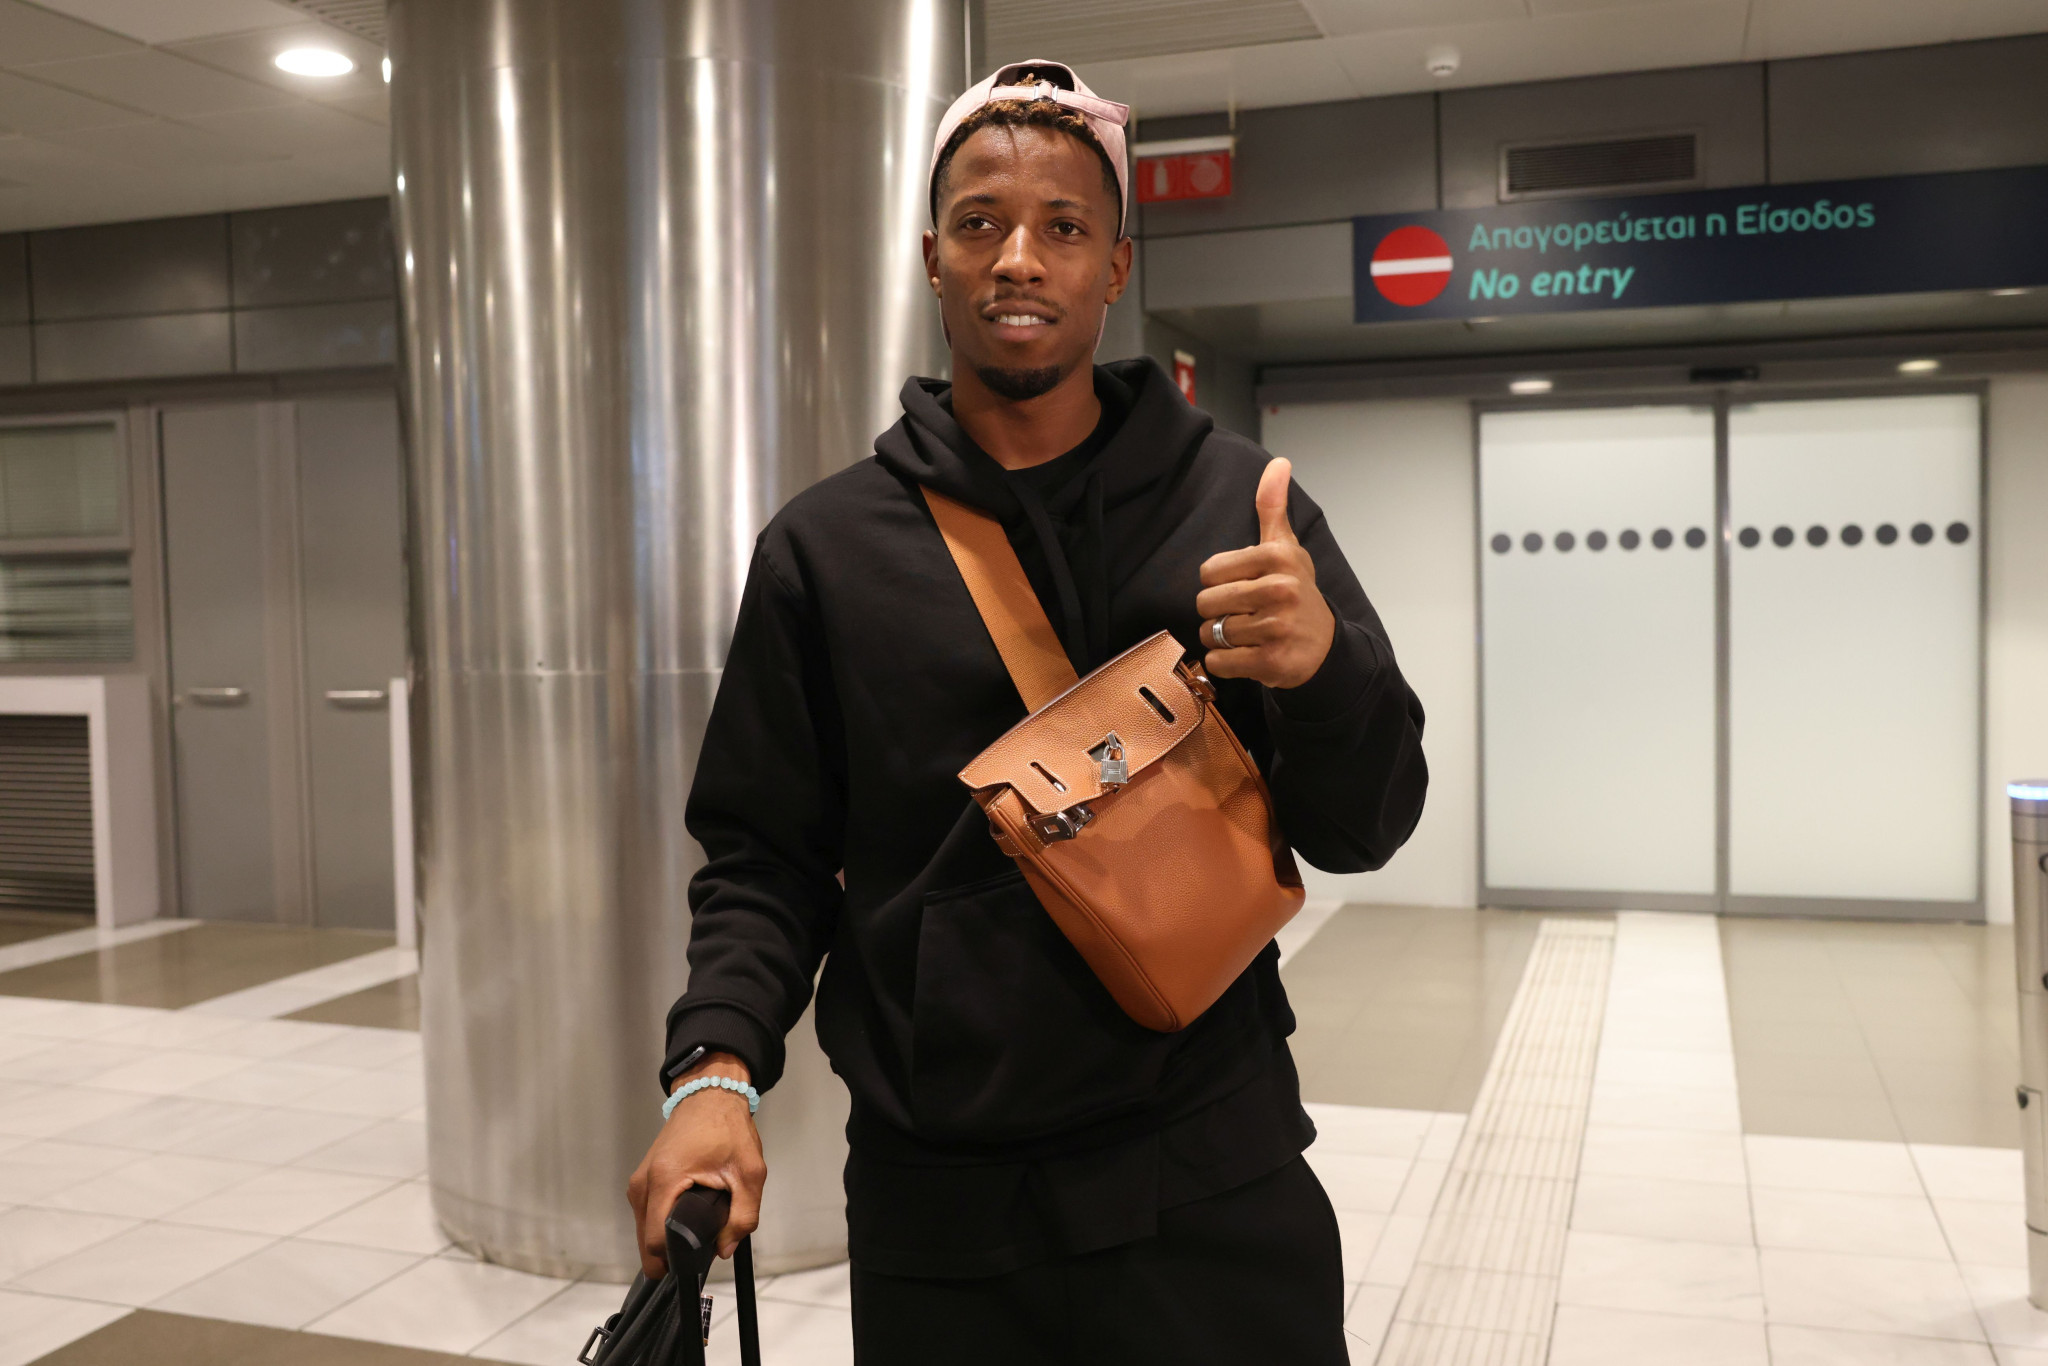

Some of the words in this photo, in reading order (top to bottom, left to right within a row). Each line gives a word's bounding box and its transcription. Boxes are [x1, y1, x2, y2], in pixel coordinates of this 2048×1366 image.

[1468, 211, 1695, 253] Απαγορεύεται
[1736, 199, 1875, 235] Είσοδος
[1469, 268, 1520, 300] No
[1530, 263, 1636, 300] entry
